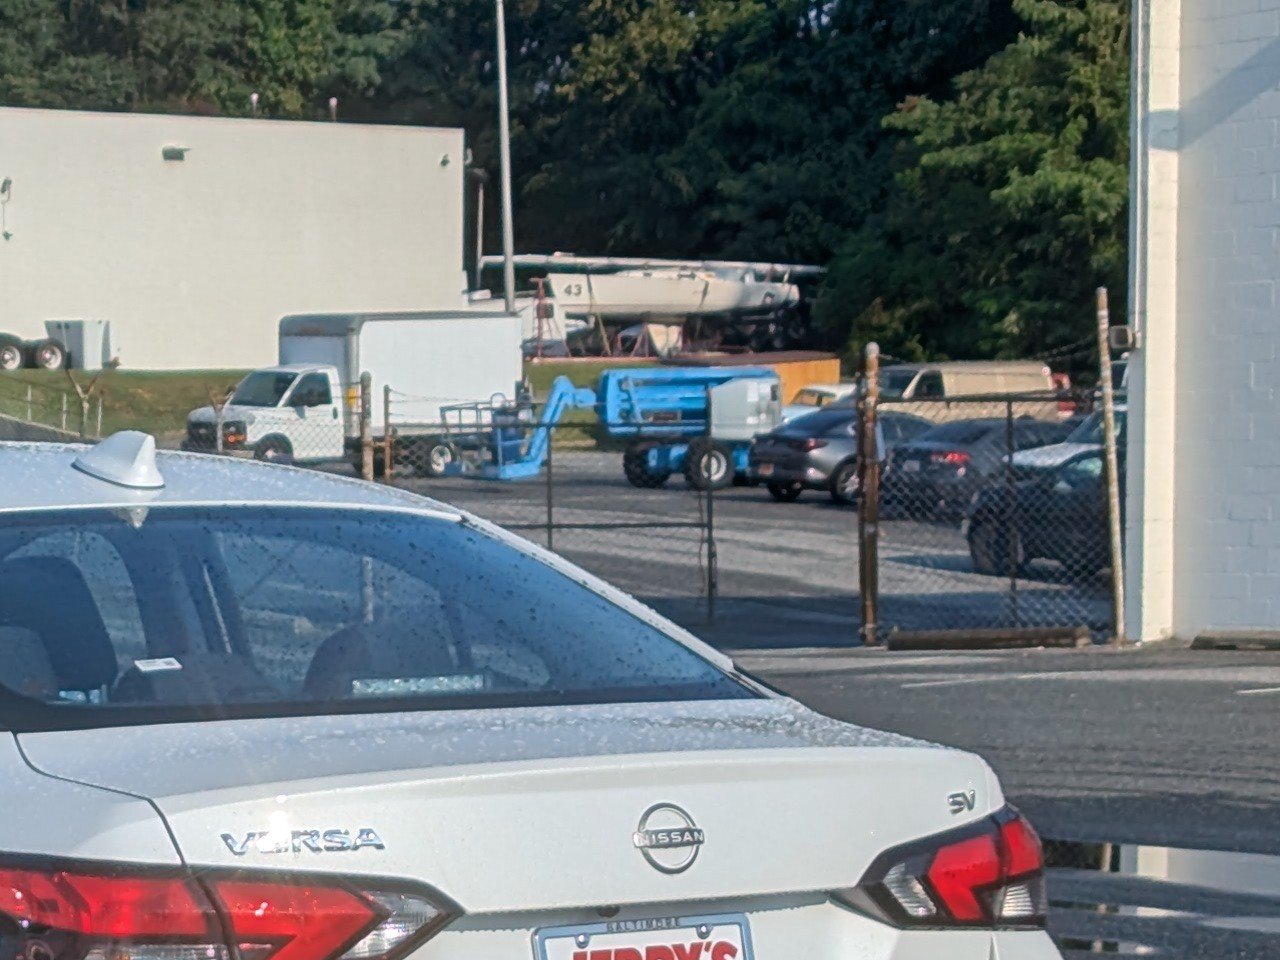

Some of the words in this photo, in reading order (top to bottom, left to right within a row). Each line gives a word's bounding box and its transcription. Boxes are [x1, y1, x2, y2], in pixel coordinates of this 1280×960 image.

[564, 284, 582, 297] 43
[947, 790, 976, 814] SV
[635, 831, 704, 847] NISSAN
